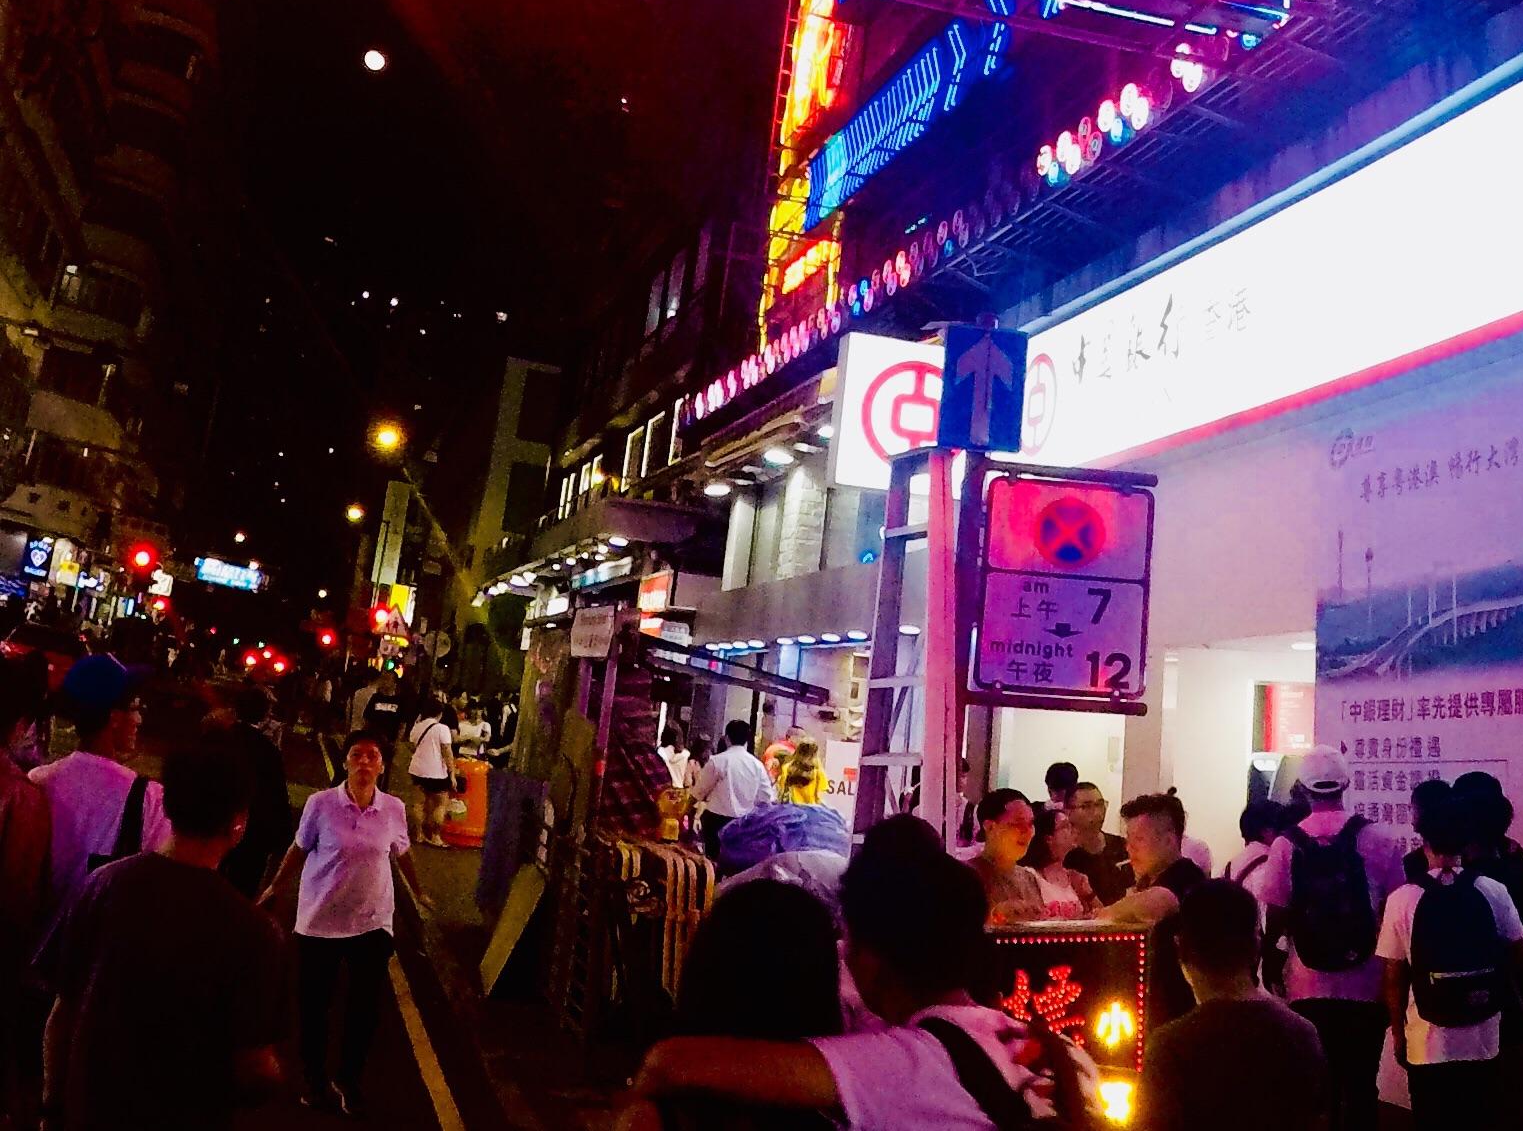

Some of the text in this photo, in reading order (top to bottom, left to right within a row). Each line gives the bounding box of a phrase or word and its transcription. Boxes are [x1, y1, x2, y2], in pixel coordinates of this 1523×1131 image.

[1010, 596, 1059, 620] 上午
[1023, 580, 1112, 625] am 7
[989, 640, 1132, 689] midnight 12
[1006, 660, 1055, 683] 午夜
[826, 779, 855, 796] SAL
